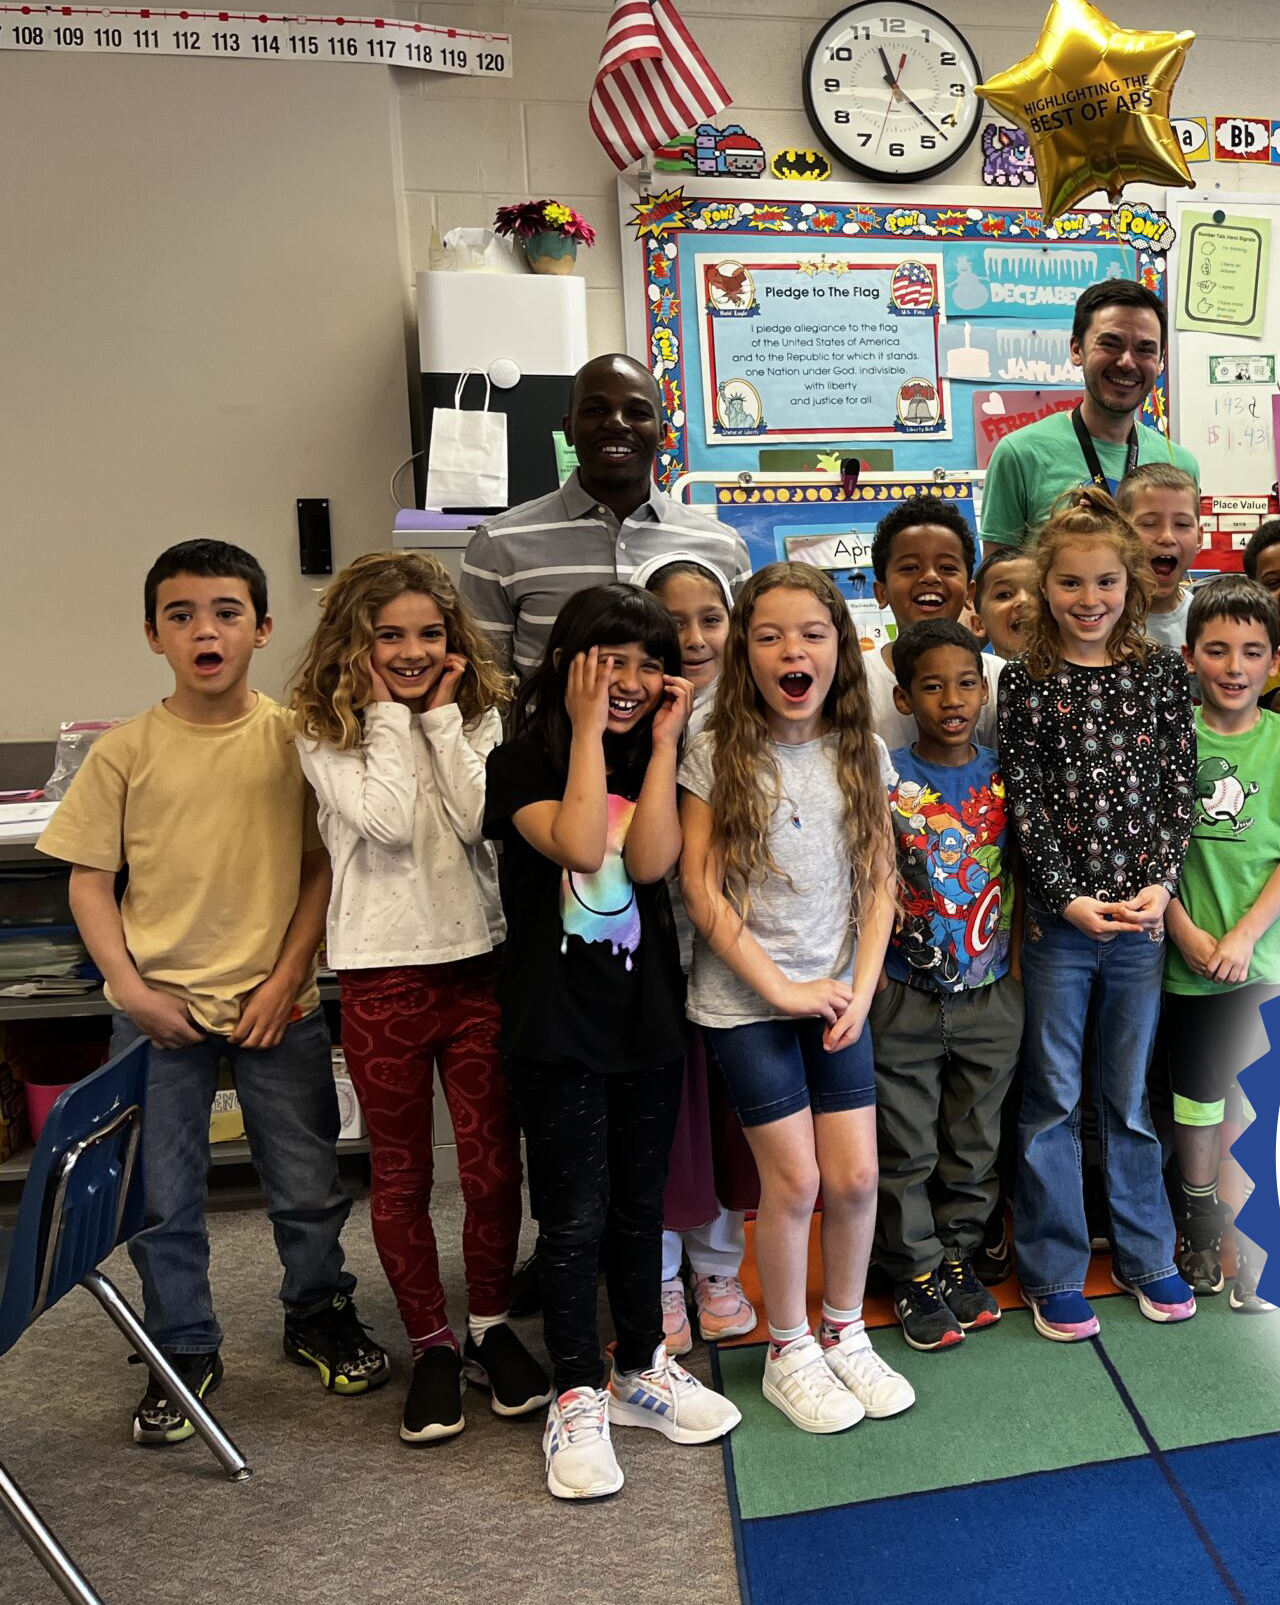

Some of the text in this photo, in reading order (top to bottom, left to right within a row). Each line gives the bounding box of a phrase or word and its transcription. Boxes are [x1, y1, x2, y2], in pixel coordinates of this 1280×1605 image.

[880, 18, 906, 33] 12
[850, 26, 870, 40] 11
[922, 30, 930, 43] 1
[12, 26, 504, 72] 108 109 110 111 112 113 114 115 116 117 118 119 120
[826, 47, 852, 62] 10
[940, 52, 956, 66] 2
[824, 78, 840, 92] 9
[950, 84, 966, 98] 3
[1024, 74, 1148, 115] HIGHLIGHTING THE
[834, 110, 850, 124] 8
[1030, 89, 1152, 134] BEST OF APS
[941, 114, 957, 128] 4
[857, 134, 872, 147] 7
[920, 136, 936, 149] 5
[1231, 124, 1254, 148] Bb
[890, 143, 904, 156] 6
[704, 206, 734, 226] POW!
[888, 213, 919, 232] POW!
[1056, 216, 1084, 236] POW!
[1119, 210, 1168, 242] POW!
[765, 286, 880, 301] Pledge to The Flag
[990, 282, 1086, 306] DECEMBE
[756, 324, 792, 334] pledge
[794, 324, 846, 334] allegiance
[848, 324, 858, 332] to
[861, 323, 877, 332] the
[879, 322, 898, 334] flag
[655, 330, 674, 362] POW!
[752, 336, 900, 348] of the United States of America
[732, 352, 753, 362] and
[755, 353, 766, 362] to
[768, 352, 784, 362] the
[787, 352, 830, 364] Republic
[832, 352, 846, 361] for
[846, 352, 876, 361] which
[878, 351, 884, 360] it
[745, 368, 765, 376] one
[767, 367, 800, 376] Nation
[802, 366, 830, 376] under
[804, 382, 858, 392] with liberty
[790, 396, 810, 406] and
[812, 396, 844, 406] justice
[846, 396, 858, 404] for
[1214, 500, 1267, 510] Place Value
[1240, 538, 1246, 547] 4
[874, 628, 880, 638] 3
